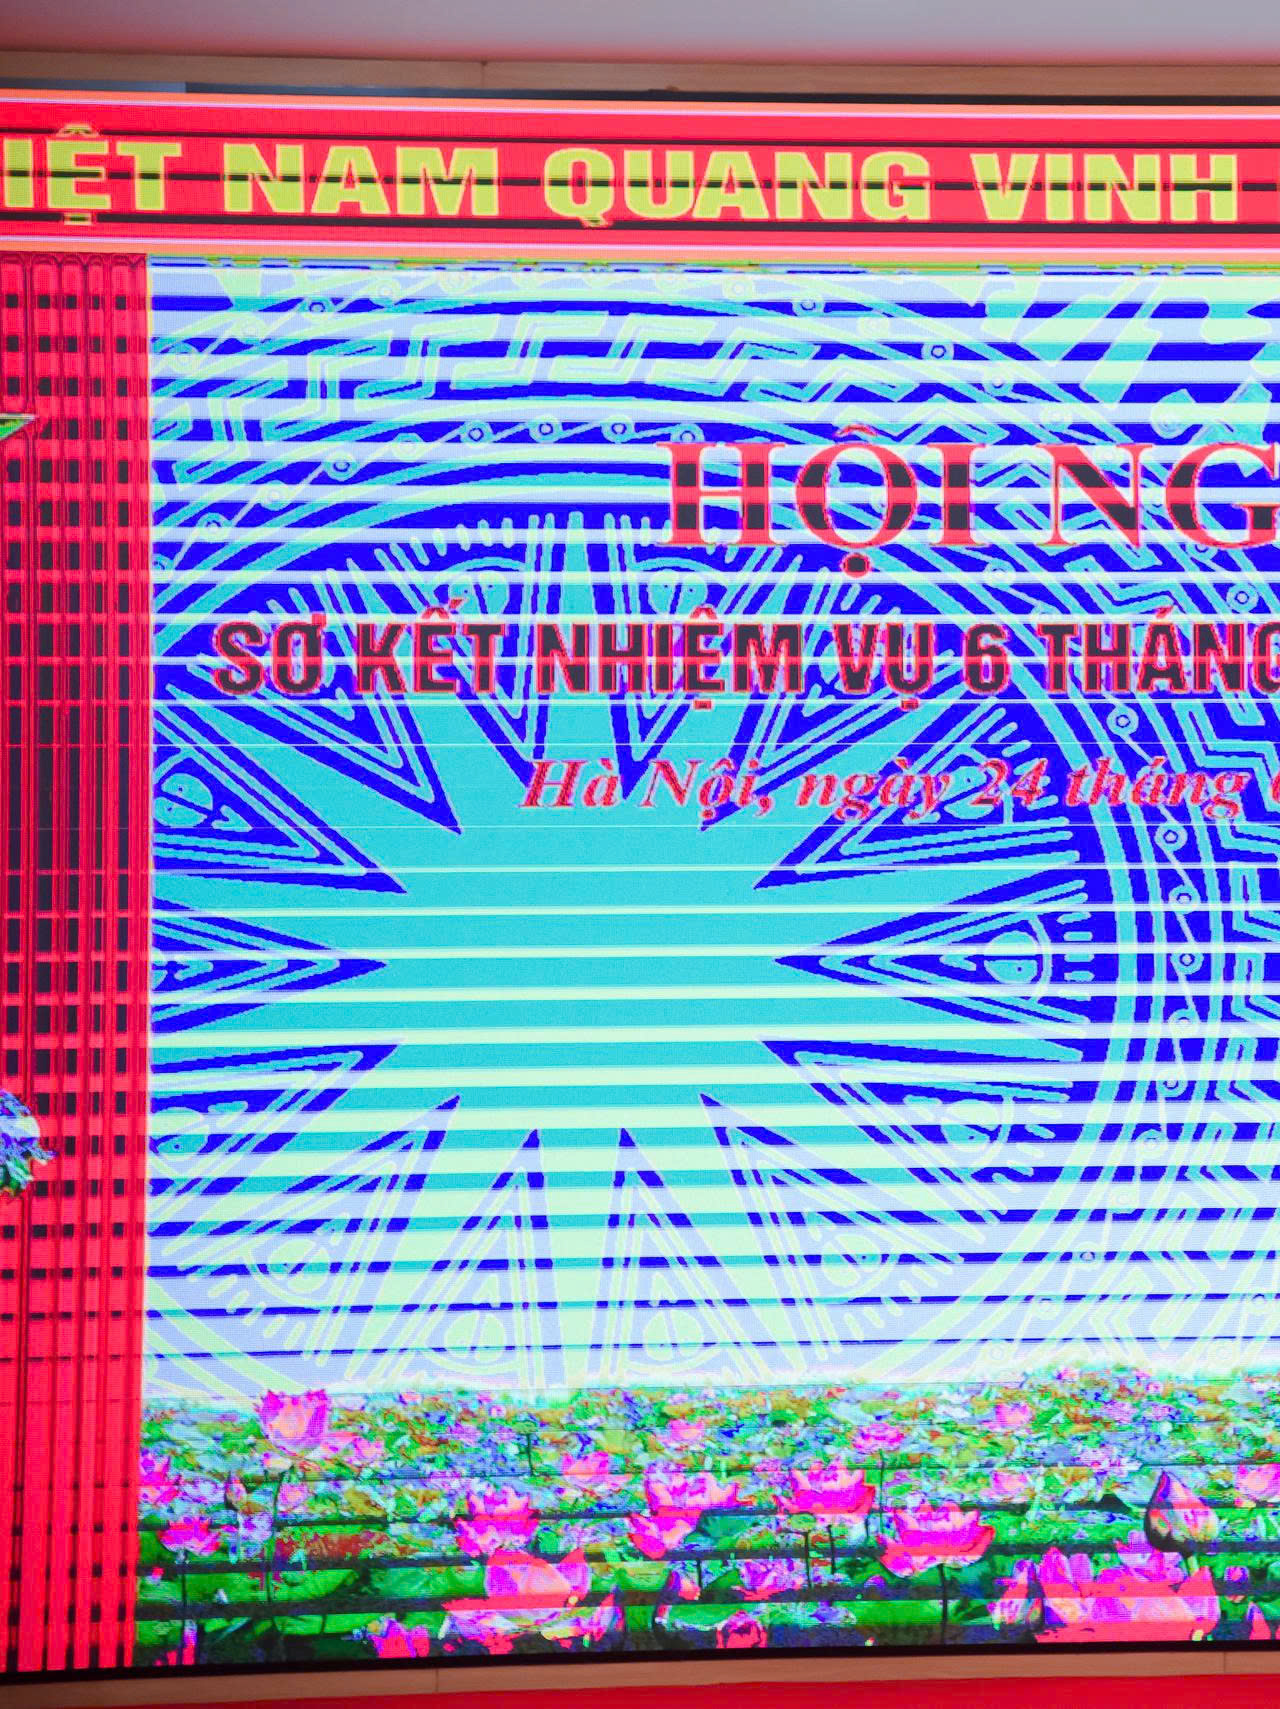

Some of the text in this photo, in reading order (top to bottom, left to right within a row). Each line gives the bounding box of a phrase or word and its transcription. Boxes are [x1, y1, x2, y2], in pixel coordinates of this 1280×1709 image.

[2, 122, 182, 226] IỆT
[223, 142, 499, 216] NAM
[543, 147, 931, 228] QUANG
[969, 152, 1238, 222] VINH
[655, 424, 991, 578] HỘI
[213, 613, 327, 695] SƠ
[354, 598, 506, 693] KẾT
[536, 606, 804, 710] NHIỆM
[832, 622, 935, 710] VỤ
[964, 621, 1010, 693] 6
[518, 757, 620, 808] Hà
[637, 757, 774, 820] Nội,
[797, 757, 952, 822] ngày
[970, 757, 1047, 806] 24
[1065, 757, 1250, 819] tháng
